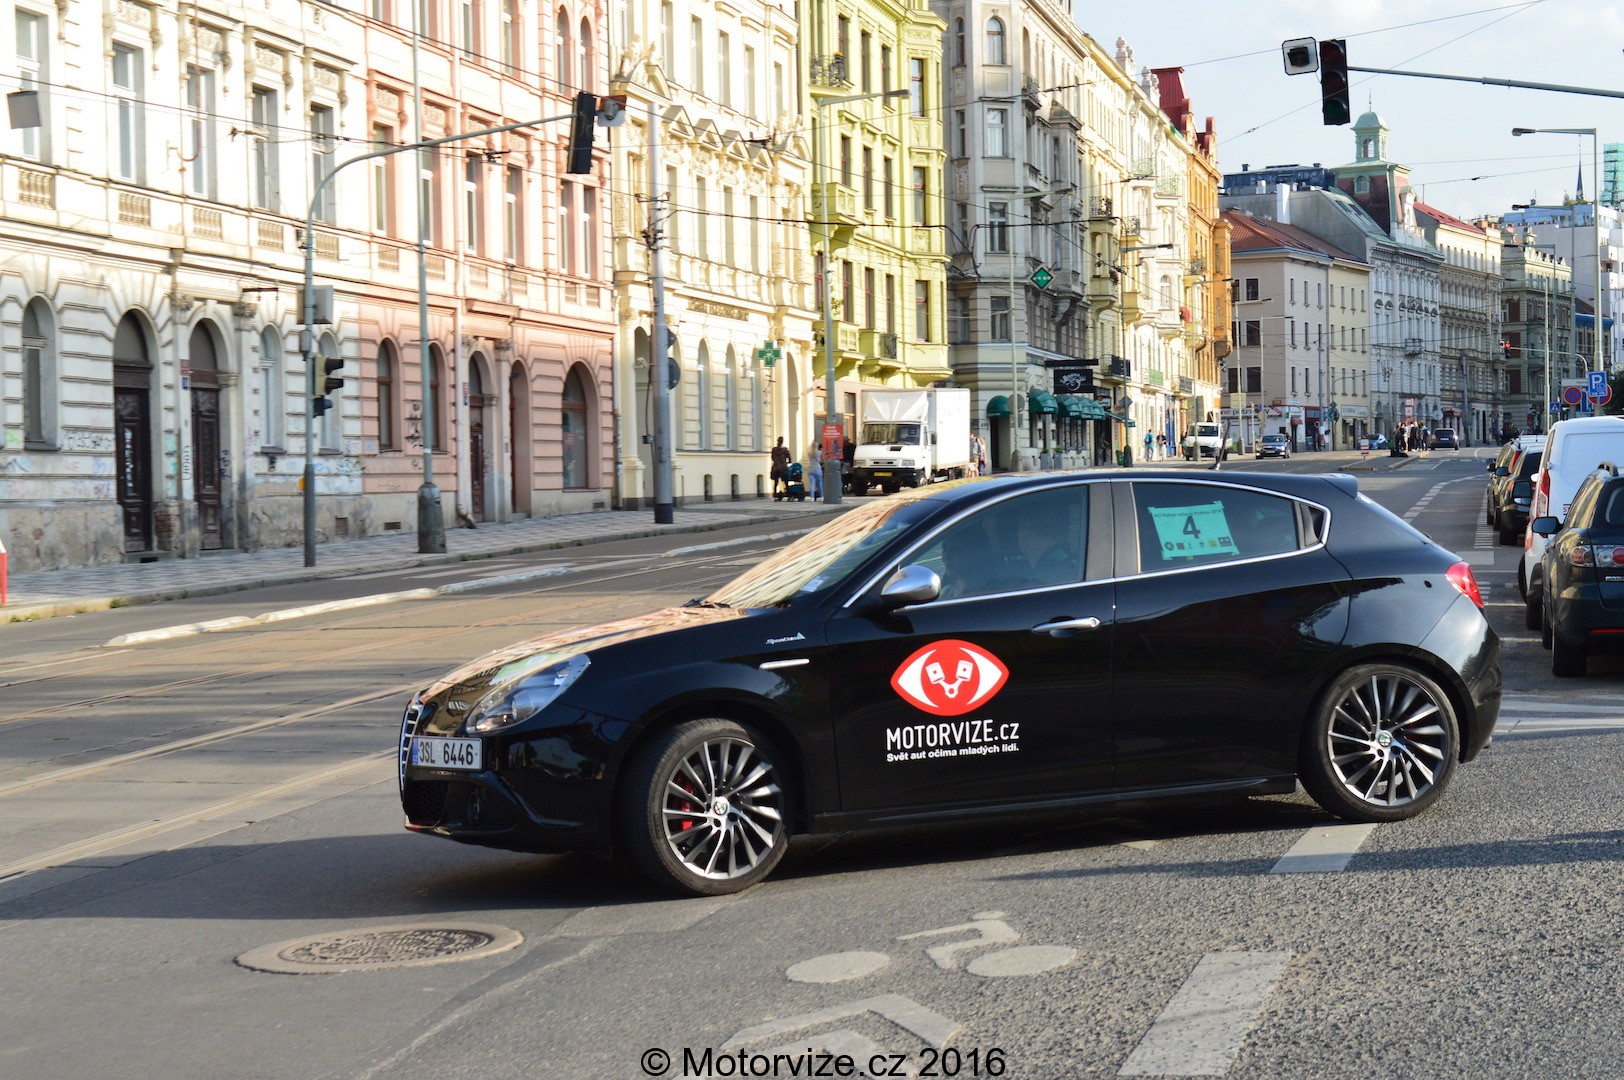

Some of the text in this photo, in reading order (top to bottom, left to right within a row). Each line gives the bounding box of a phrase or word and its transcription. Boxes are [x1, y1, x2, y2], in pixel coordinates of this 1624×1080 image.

[1591, 374, 1602, 390] P
[1183, 515, 1201, 539] 4
[419, 741, 474, 766] 3SL 6446
[886, 752, 909, 763] Svět
[910, 750, 926, 760] aut
[928, 747, 958, 759] očima
[959, 744, 999, 757] mladých
